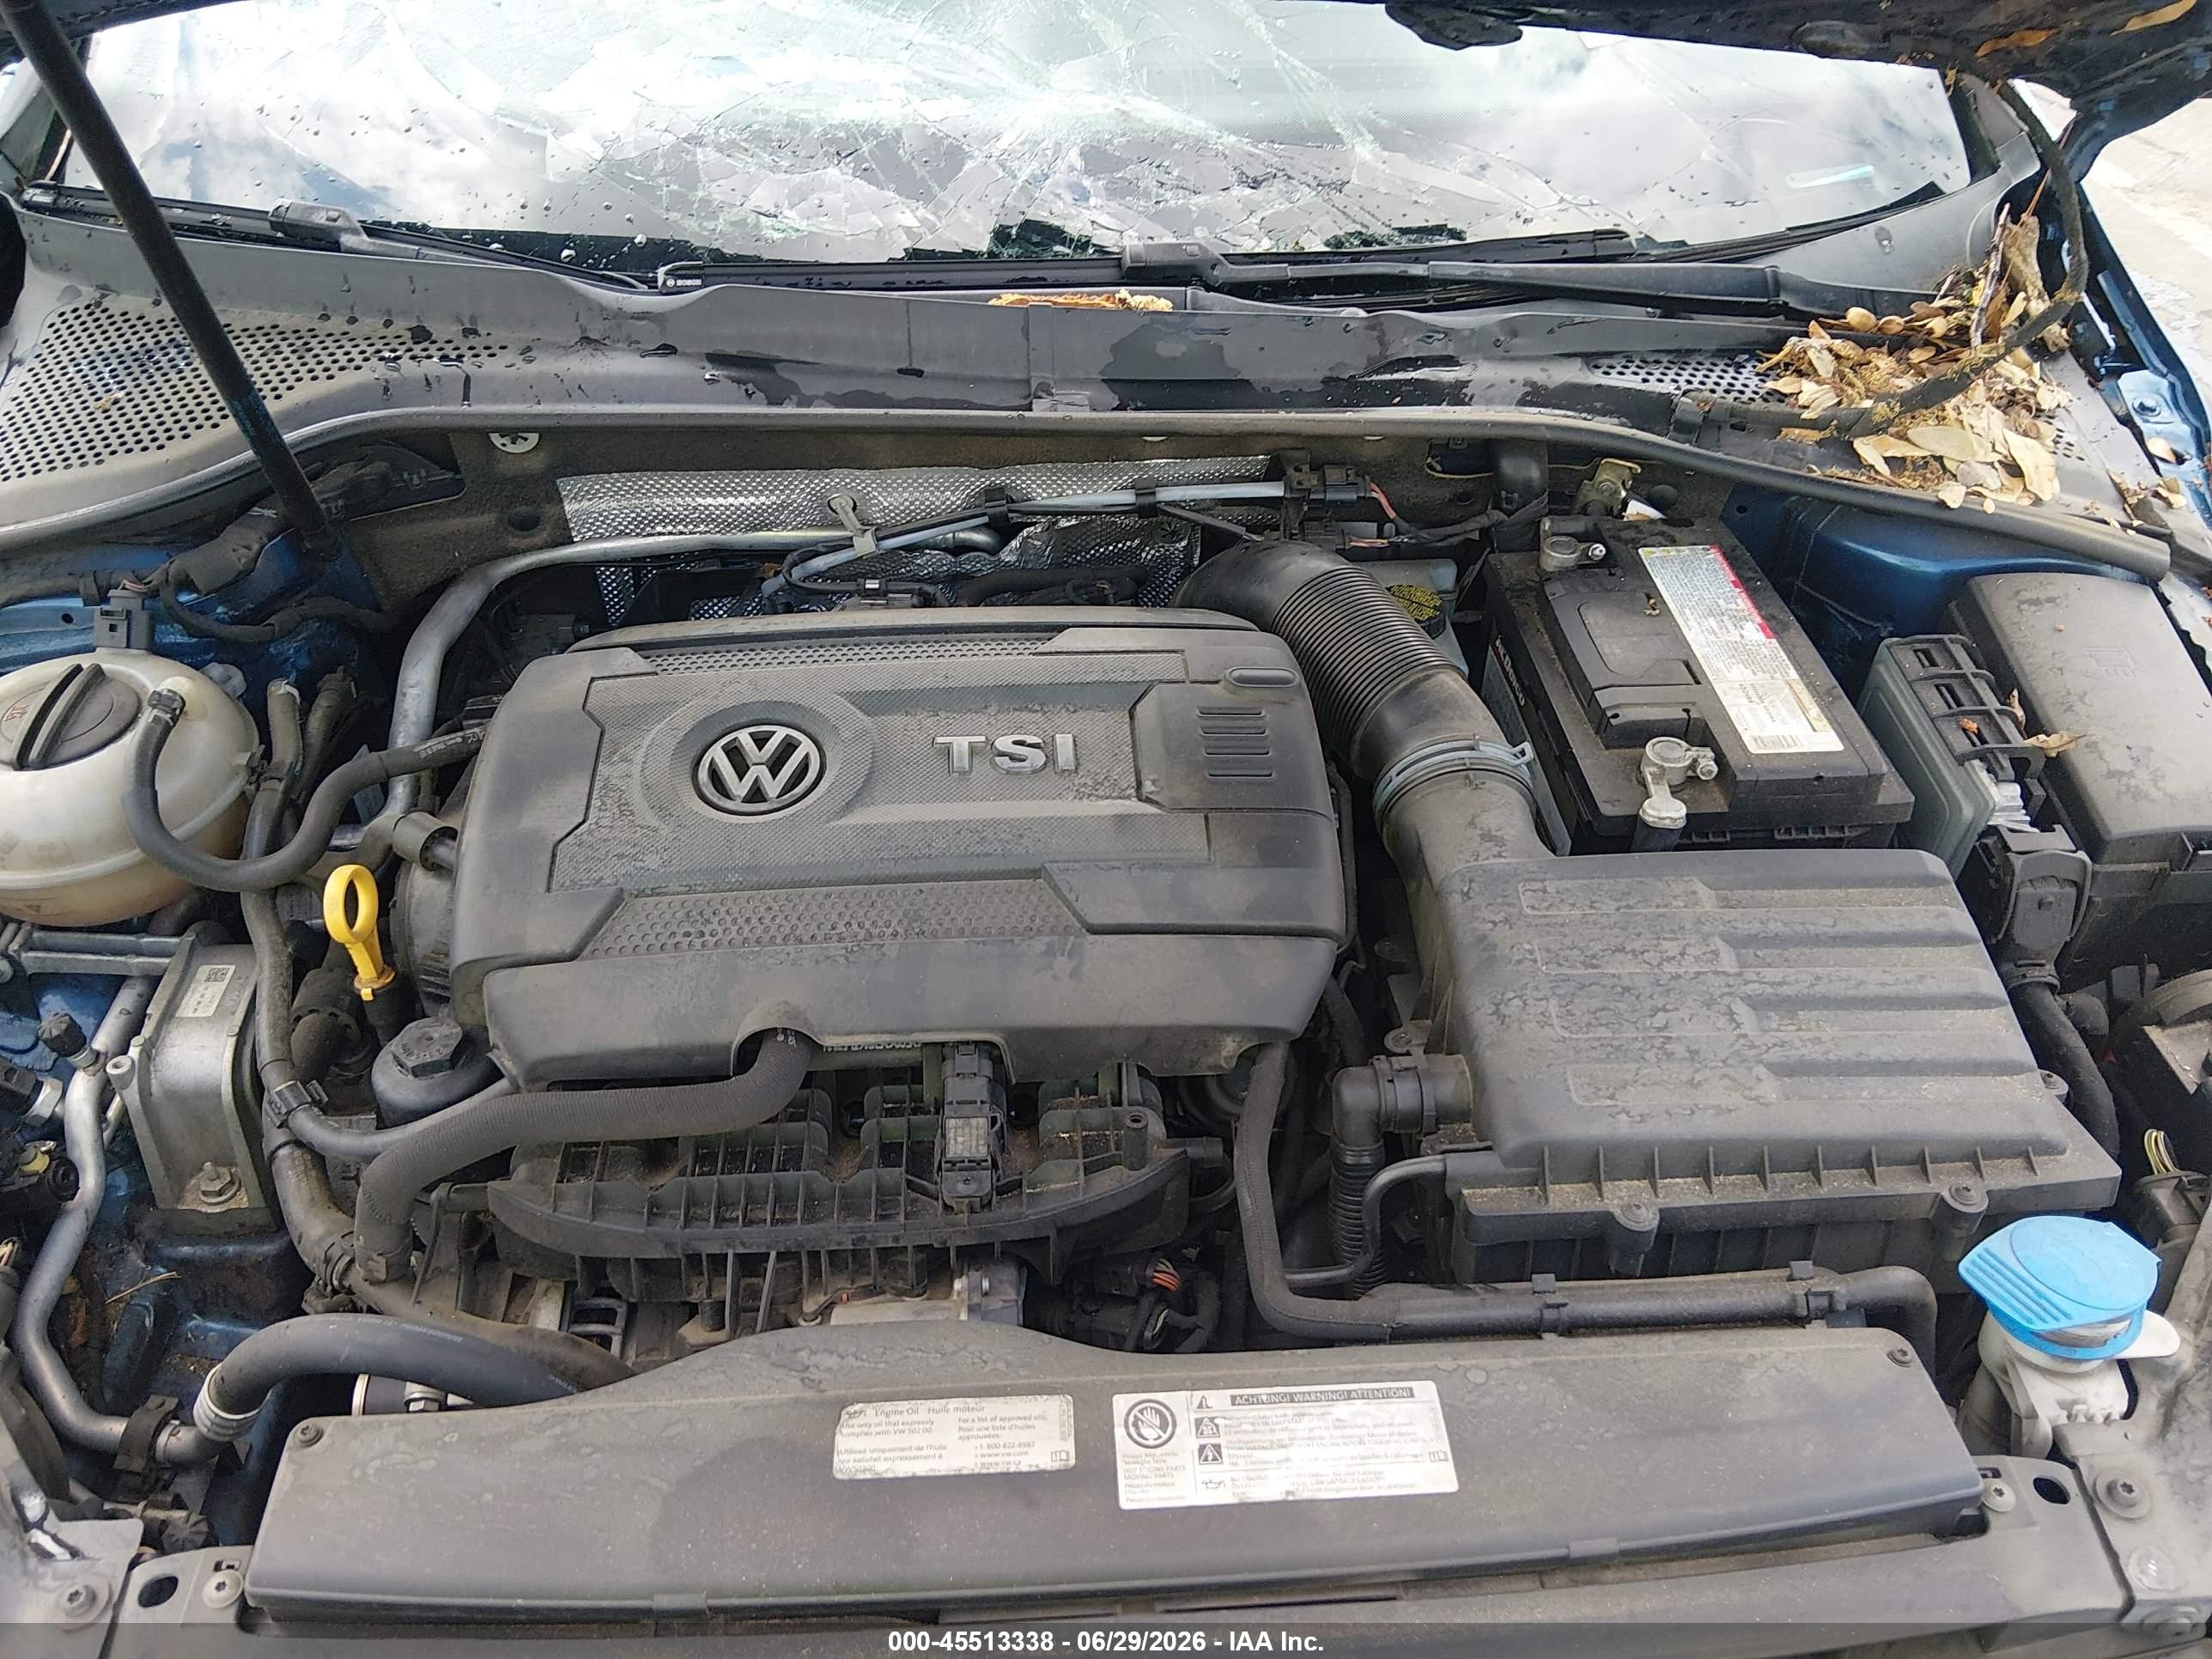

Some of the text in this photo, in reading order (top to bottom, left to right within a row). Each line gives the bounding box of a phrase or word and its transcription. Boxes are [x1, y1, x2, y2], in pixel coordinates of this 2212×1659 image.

[934, 733, 1077, 774] TSI
[1235, 1388, 1410, 1405] ACHTUNG! WARNING! ATTENTION!
[875, 1407, 904, 1418] Engine
[927, 1405, 950, 1414] Huile
[856, 1421, 872, 1430] only
[901, 1419, 934, 1427] expressly
[999, 1414, 1031, 1423] approved
